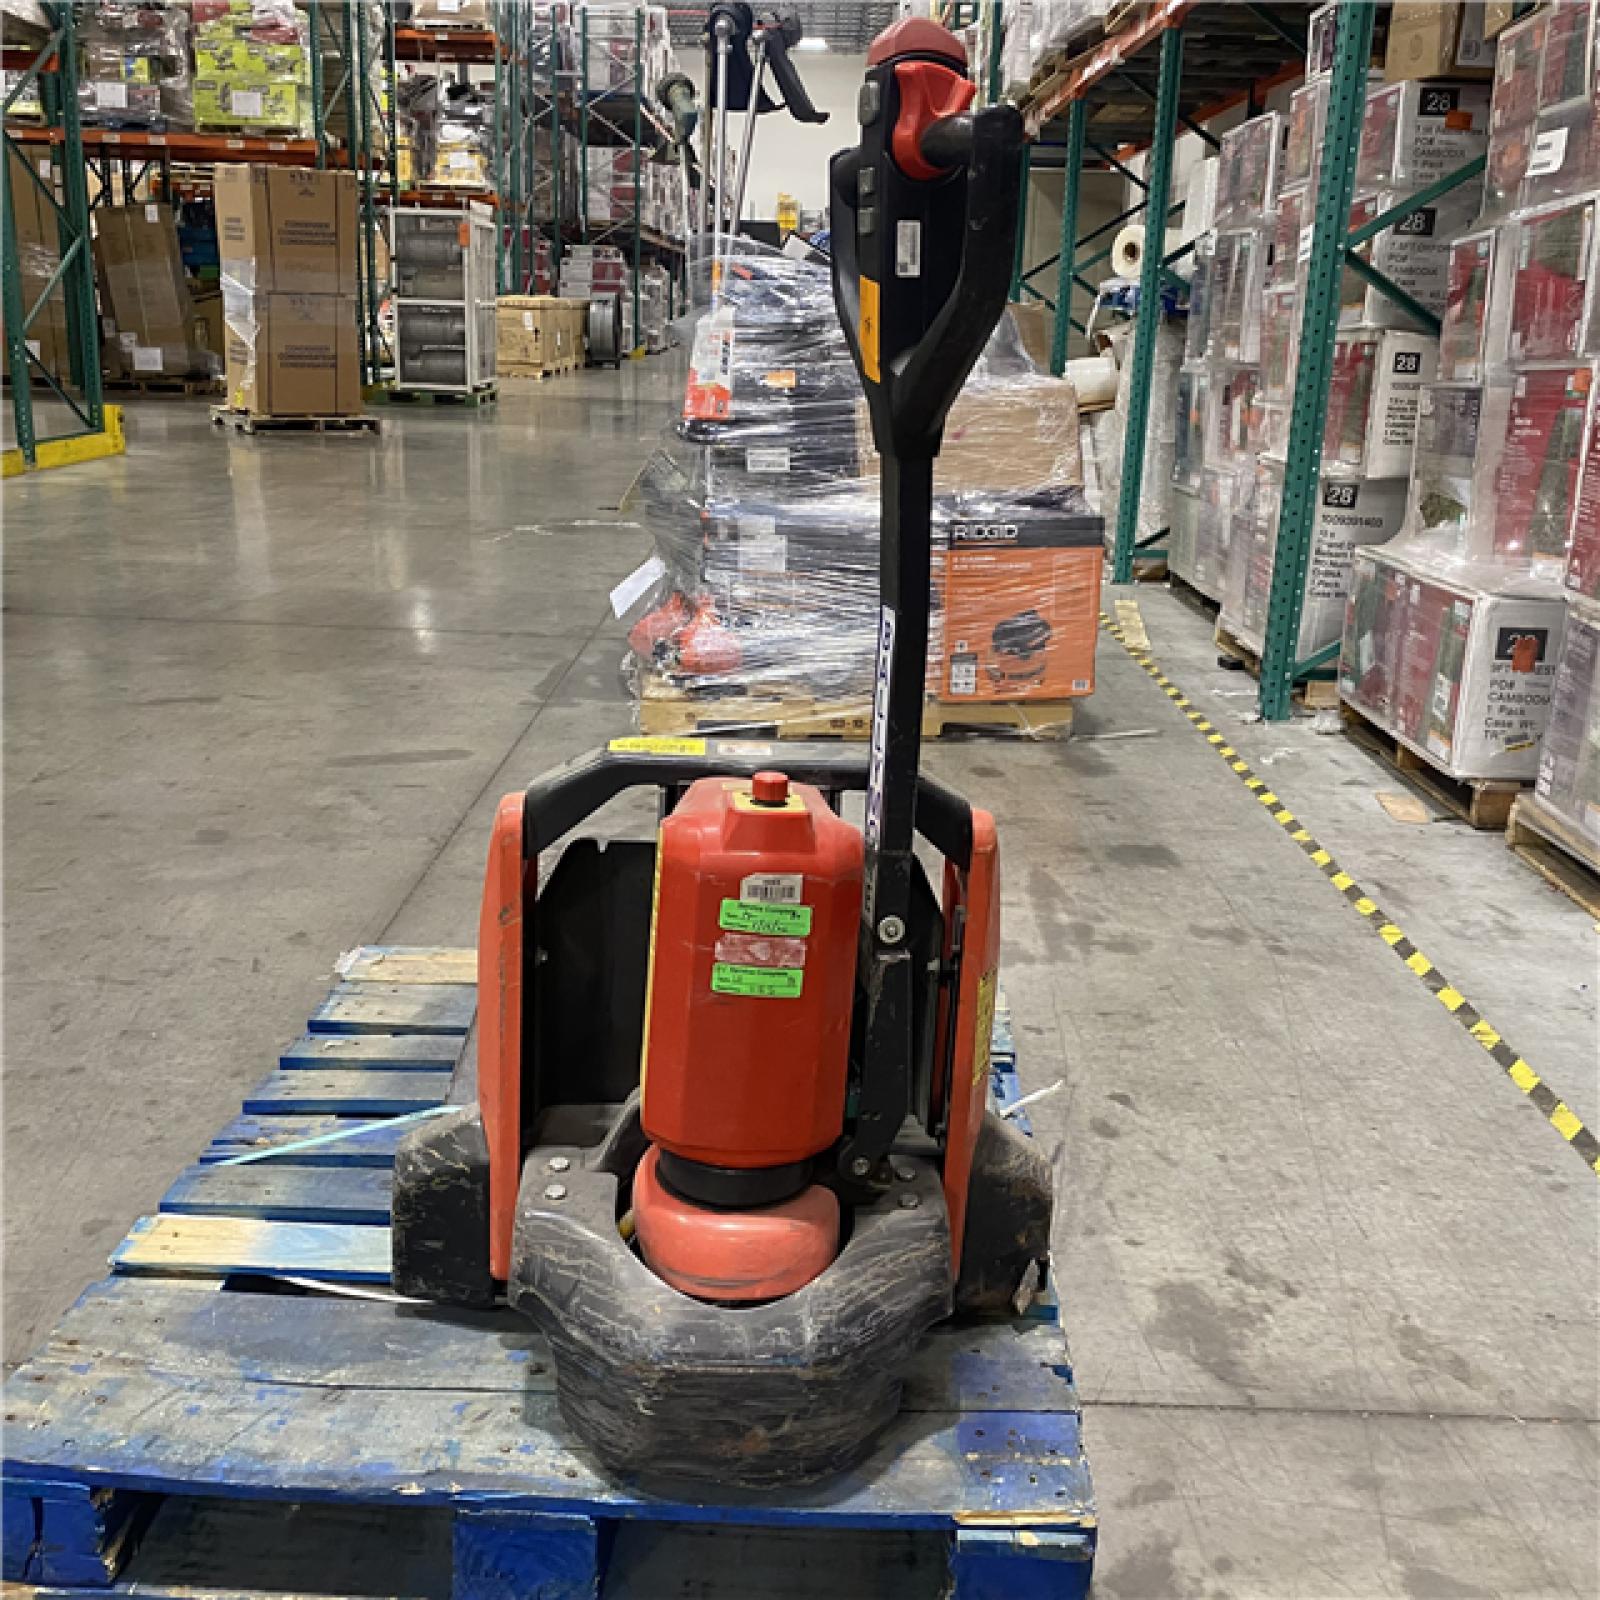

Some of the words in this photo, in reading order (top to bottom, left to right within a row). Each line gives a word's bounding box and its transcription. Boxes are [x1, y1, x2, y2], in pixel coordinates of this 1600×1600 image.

[1426, 91, 1451, 112] 28
[1400, 212, 1426, 231] 28
[1396, 354, 1416, 371] 28
[1328, 487, 1353, 504] 28
[954, 524, 1018, 538] RIDGID
[1489, 679, 1516, 691] PO#
[1484, 717, 1513, 729] Case
